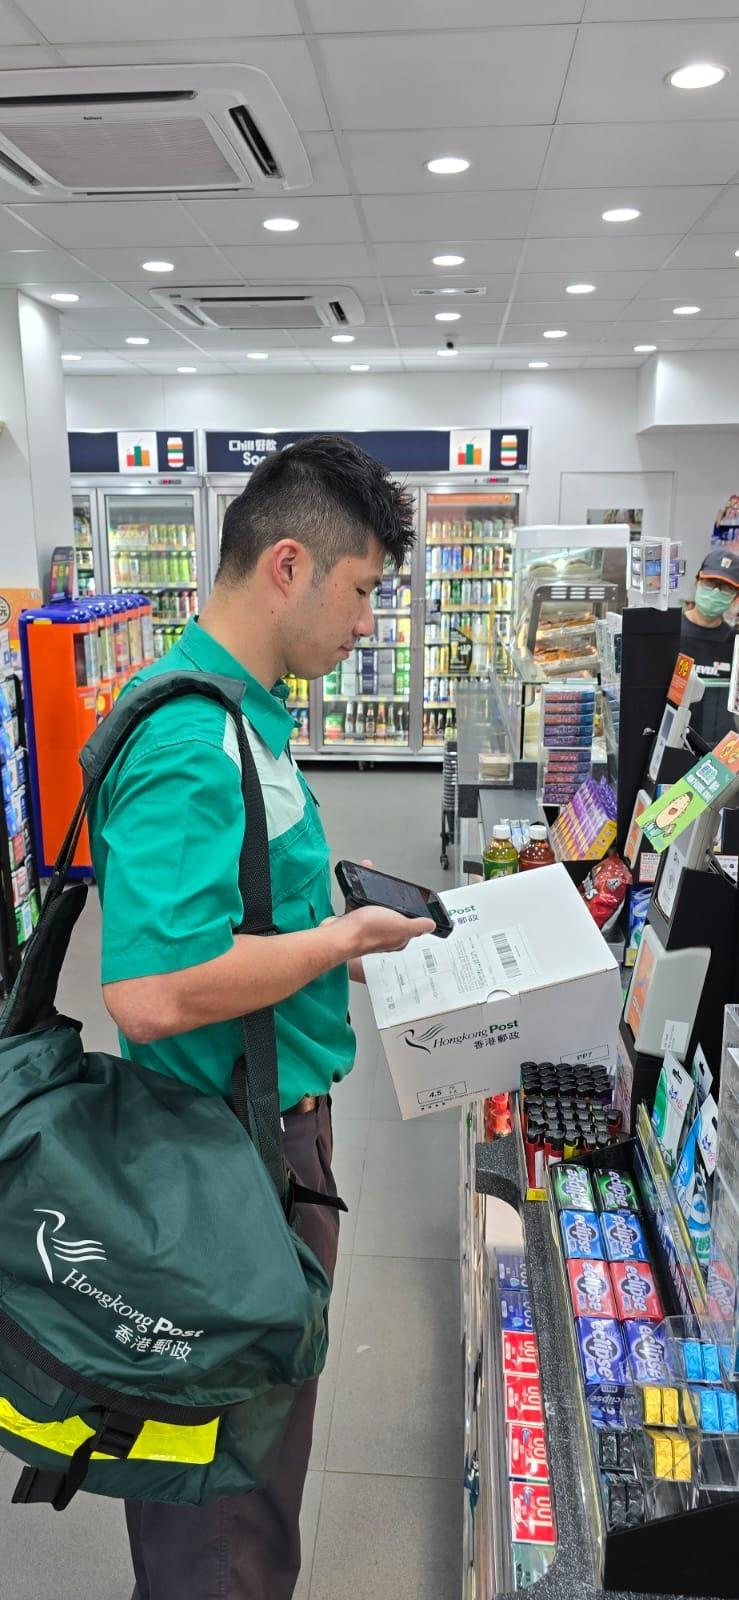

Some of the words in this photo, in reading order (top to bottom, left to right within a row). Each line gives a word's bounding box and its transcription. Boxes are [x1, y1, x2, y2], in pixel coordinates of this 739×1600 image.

[432, 1030, 488, 1049] Hongkong
[489, 1019, 519, 1034] Post
[474, 1031, 520, 1050] 香港郵政
[608, 1171, 629, 1207] eclipse
[572, 1215, 593, 1255] eclipse
[613, 1216, 634, 1256] eclipse
[61, 1268, 154, 1333] Hongkong
[153, 1317, 204, 1338] Post
[581, 1262, 602, 1311] eclipse
[625, 1265, 648, 1312] eclipse
[114, 1323, 192, 1363] 香港郵政
[589, 1320, 614, 1379] eclipse
[639, 1325, 664, 1380] eclipse
